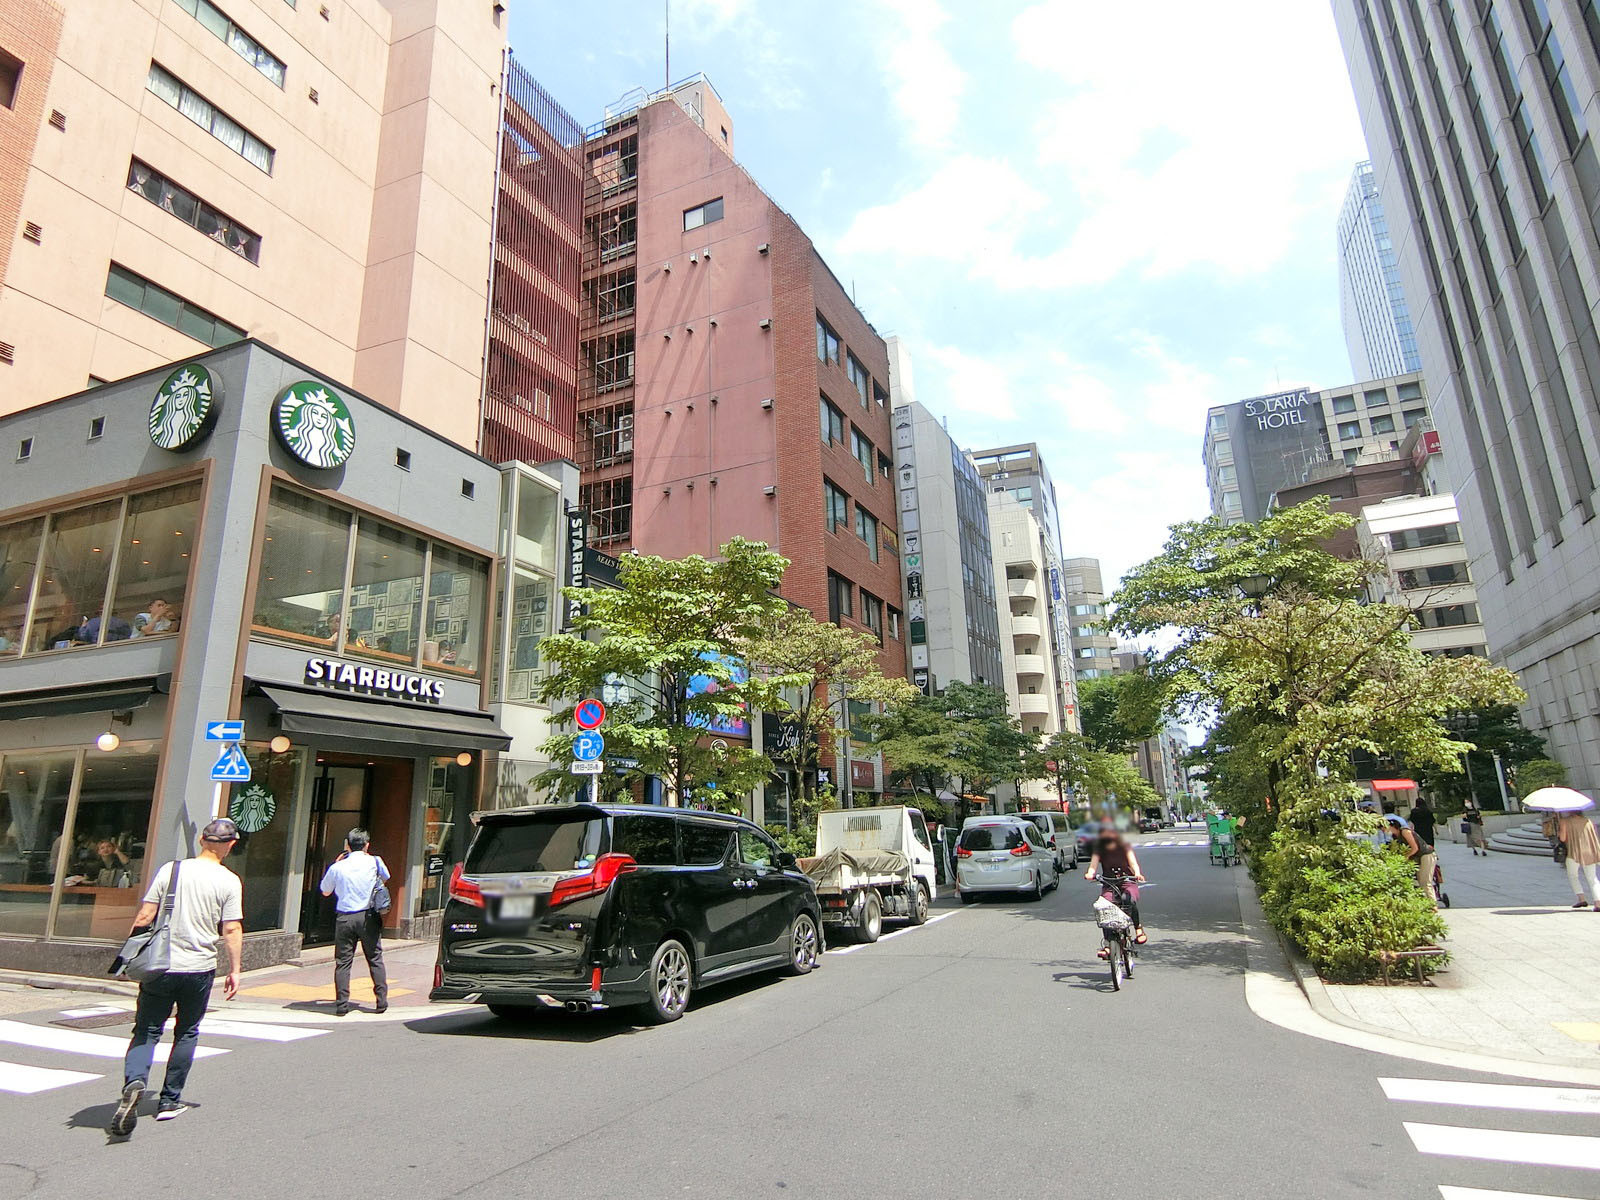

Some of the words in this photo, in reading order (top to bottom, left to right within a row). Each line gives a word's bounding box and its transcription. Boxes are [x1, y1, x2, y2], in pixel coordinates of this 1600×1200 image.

[1245, 392, 1309, 416] SOLARIA
[1257, 409, 1306, 430] HOTEL
[570, 518, 584, 618] STARBUKS
[307, 658, 445, 698] STARBUCKS
